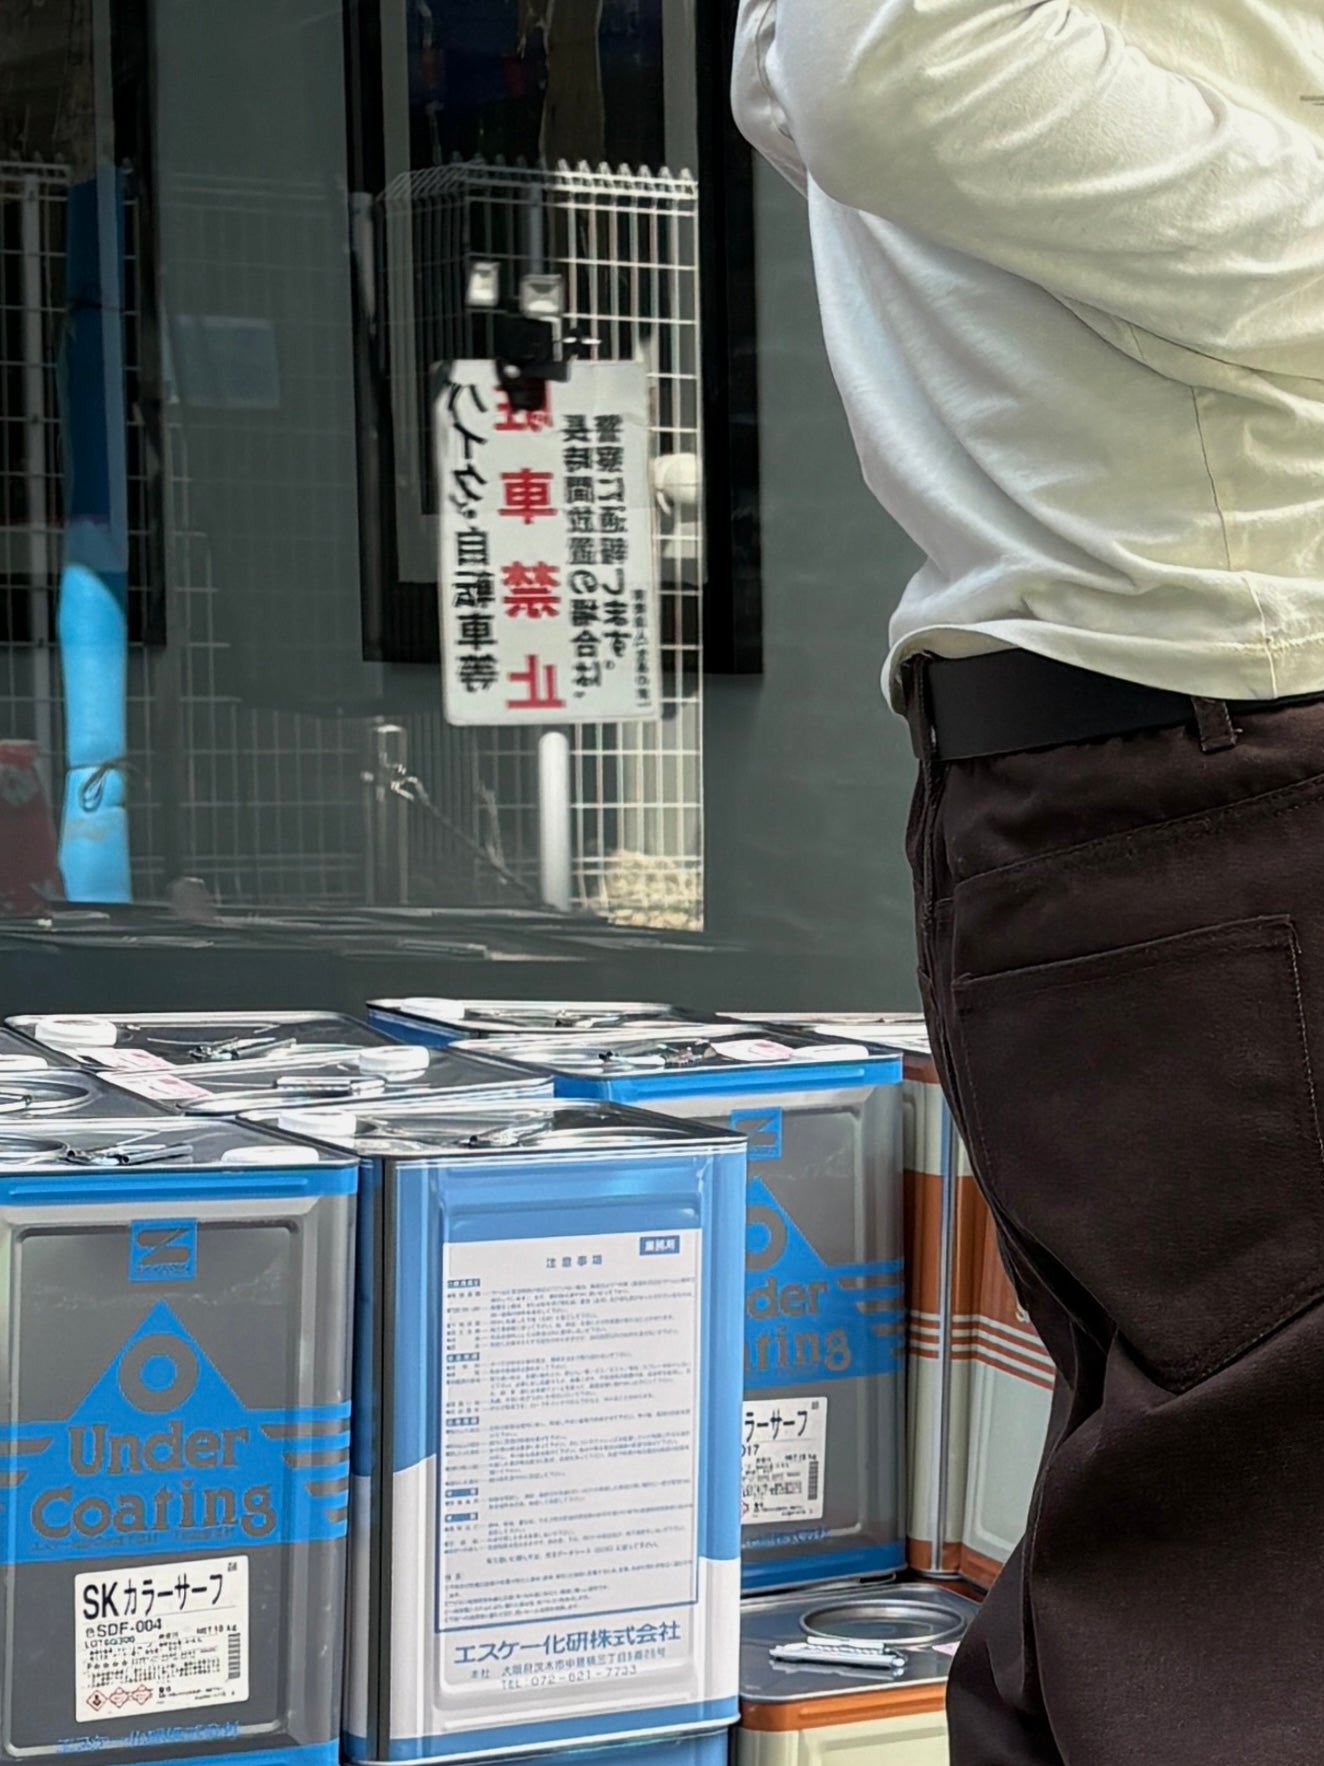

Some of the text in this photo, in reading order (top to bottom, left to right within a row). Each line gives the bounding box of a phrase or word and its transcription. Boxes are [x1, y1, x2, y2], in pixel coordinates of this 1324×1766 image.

[748, 1276, 828, 1320] der
[67, 1419, 249, 1475] Under
[31, 1479, 277, 1538] Coating
[454, 1620, 681, 1664] エスケー化研株式会社
